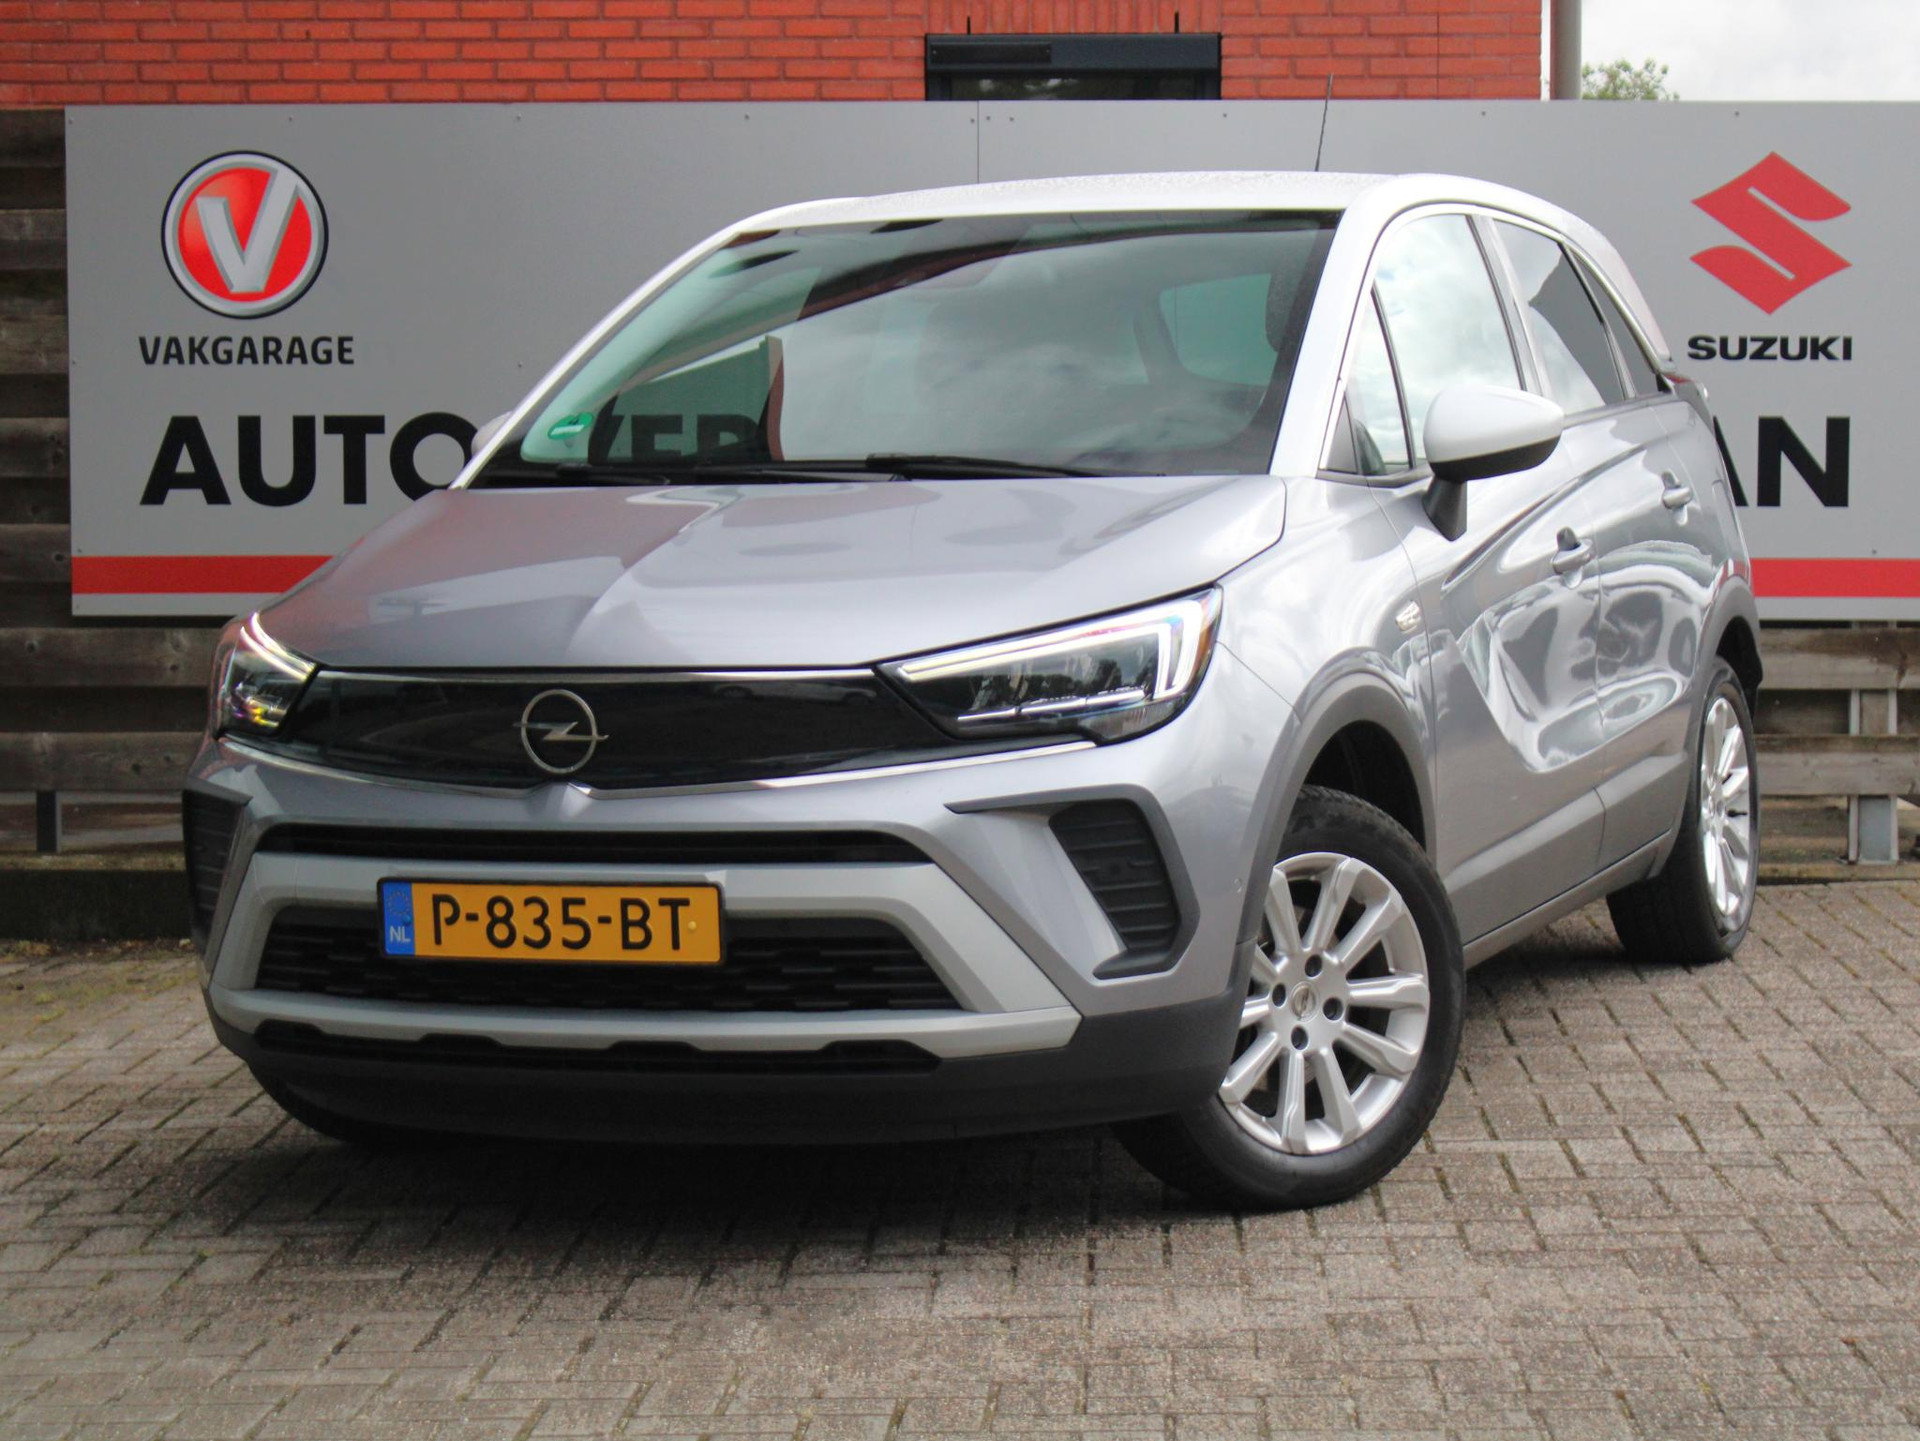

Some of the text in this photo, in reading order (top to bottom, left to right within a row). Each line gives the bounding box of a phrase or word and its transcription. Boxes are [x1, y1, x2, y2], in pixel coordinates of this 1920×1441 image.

[138, 335, 355, 366] VAKGARAGE
[1687, 335, 1852, 361] SUZUKI
[389, 926, 411, 943] NL
[431, 893, 691, 951] P-835-BT
